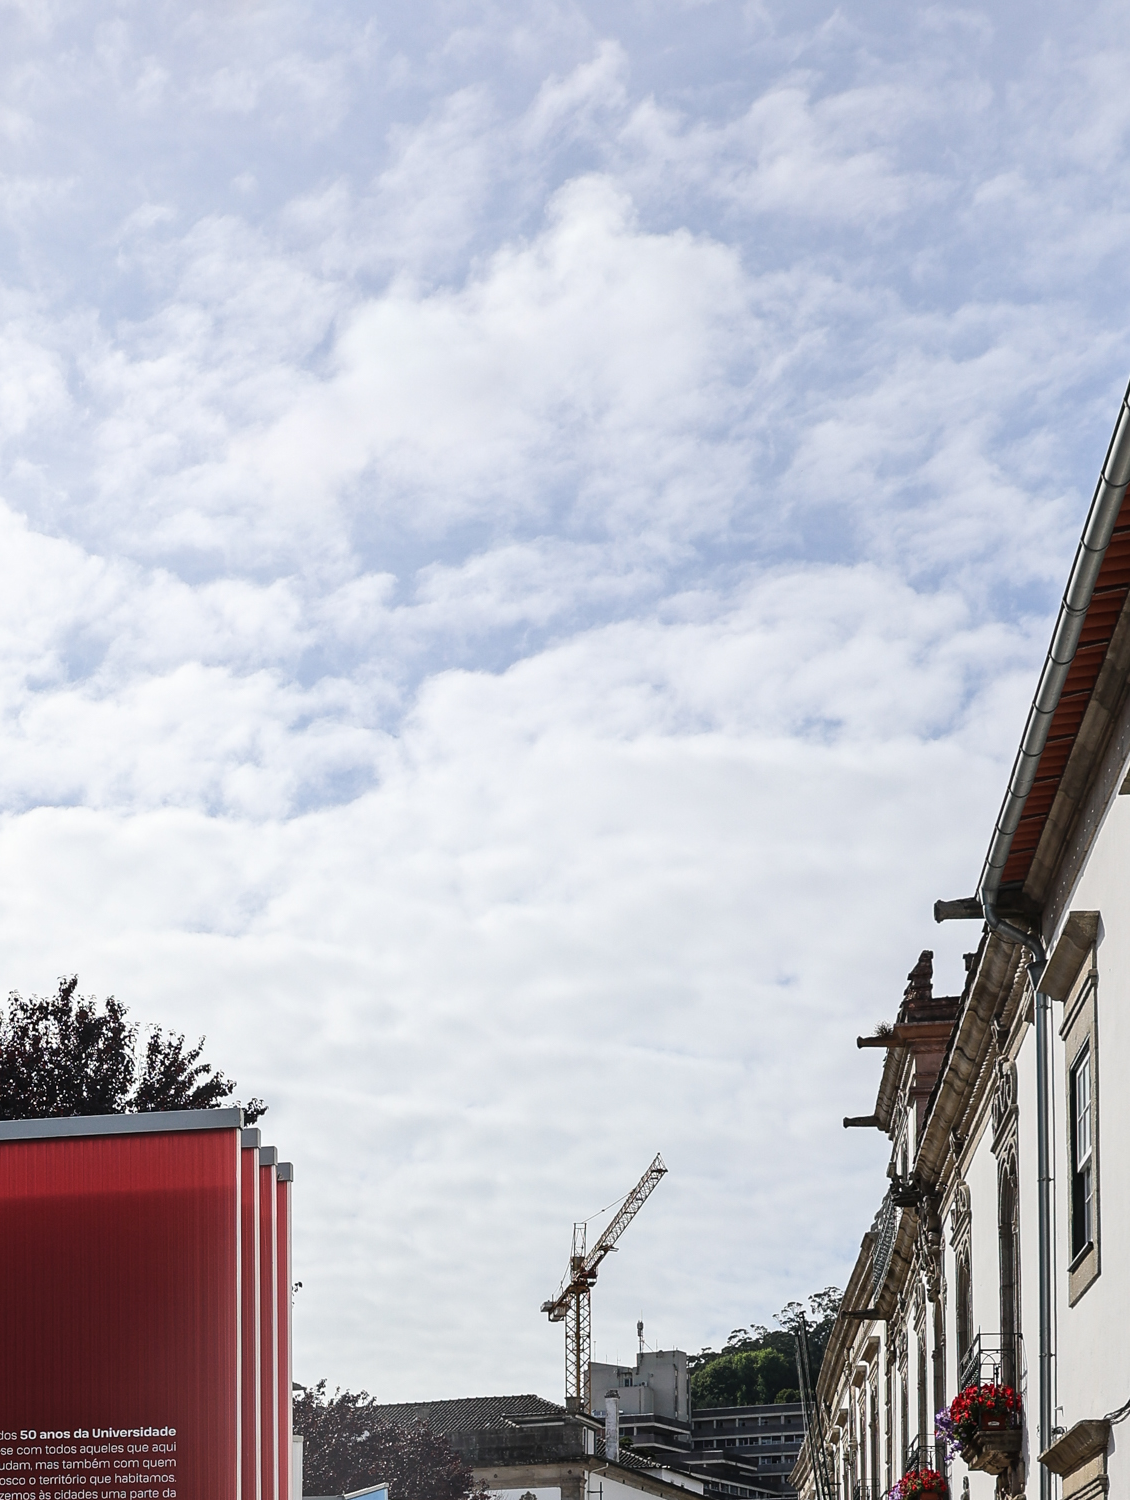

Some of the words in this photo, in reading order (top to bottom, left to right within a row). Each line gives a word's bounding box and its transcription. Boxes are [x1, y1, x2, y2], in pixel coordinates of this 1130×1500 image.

[20, 1430, 37, 1440] 50
[39, 1430, 71, 1440] anos
[73, 1428, 89, 1439] da
[92, 1426, 177, 1438] Universidade
[16, 1446, 43, 1455] com
[44, 1444, 77, 1455] todos
[79, 1442, 125, 1456] aqueles
[126, 1444, 149, 1455] que
[151, 1441, 177, 1454] aqui
[35, 1461, 60, 1470] mas
[61, 1458, 111, 1470] também
[113, 1459, 140, 1469] com
[142, 1458, 177, 1470] quem
[28, 1477, 36, 1485] o
[39, 1474, 87, 1485] território
[89, 1475, 112, 1486] que
[114, 1473, 177, 1484] habitamos.
[38, 1489, 52, 1500] às
[54, 1489, 99, 1500] cidades
[101, 1490, 127, 1500] uma
[129, 1489, 160, 1500] parte
[162, 1487, 177, 1498] da
